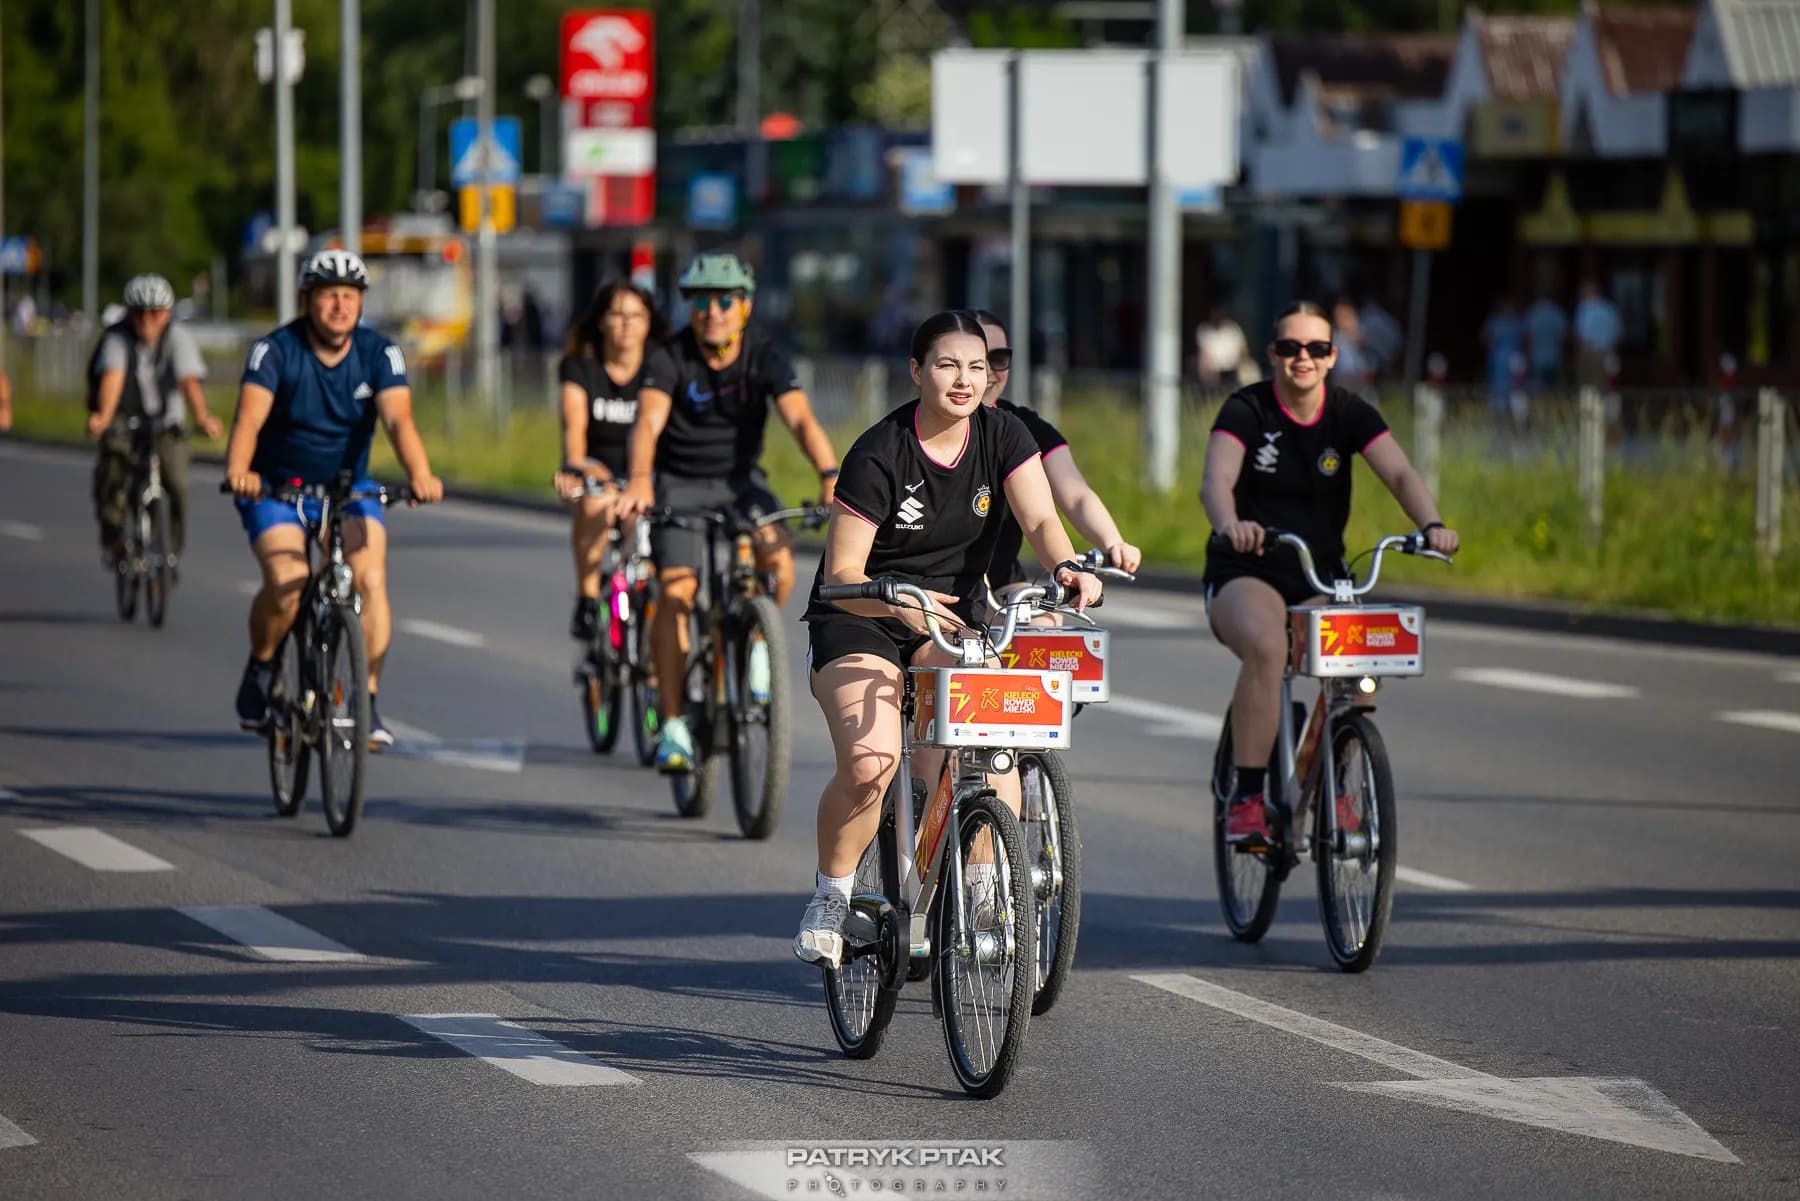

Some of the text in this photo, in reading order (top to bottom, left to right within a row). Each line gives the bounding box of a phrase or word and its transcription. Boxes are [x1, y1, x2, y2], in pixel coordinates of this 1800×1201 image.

[1050, 650, 1083, 658] KIELECKI
[1050, 663, 1079, 671] MIEJSKI
[1004, 691, 1041, 700] KIELECKI
[1004, 699, 1035, 707] ROWER
[1003, 705, 1036, 714] MIEJSKI
